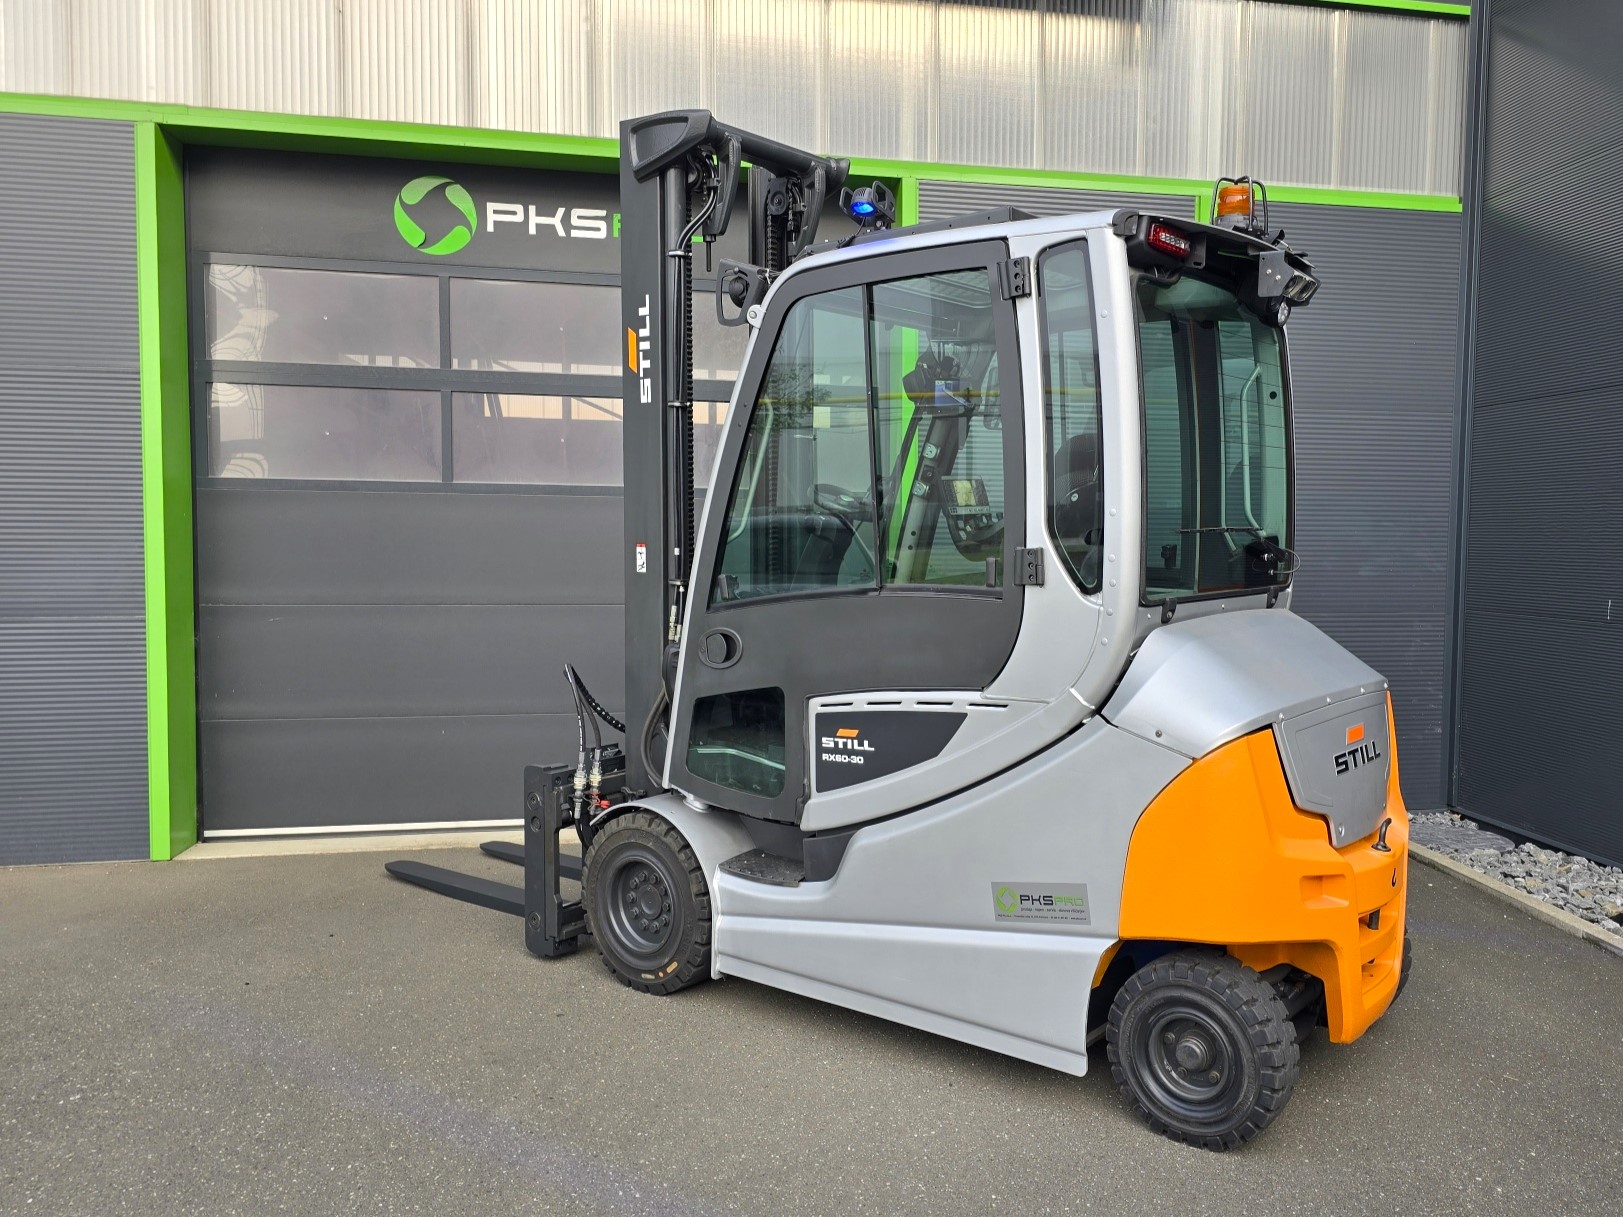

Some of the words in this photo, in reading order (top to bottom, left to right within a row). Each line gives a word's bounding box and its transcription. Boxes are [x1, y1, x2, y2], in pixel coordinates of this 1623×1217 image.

[638, 294, 652, 404] STILL
[821, 736, 875, 751] STILL
[822, 753, 865, 764] RX60-30
[1333, 739, 1381, 776] STILL
[1019, 894, 1085, 907] PKSPRO
